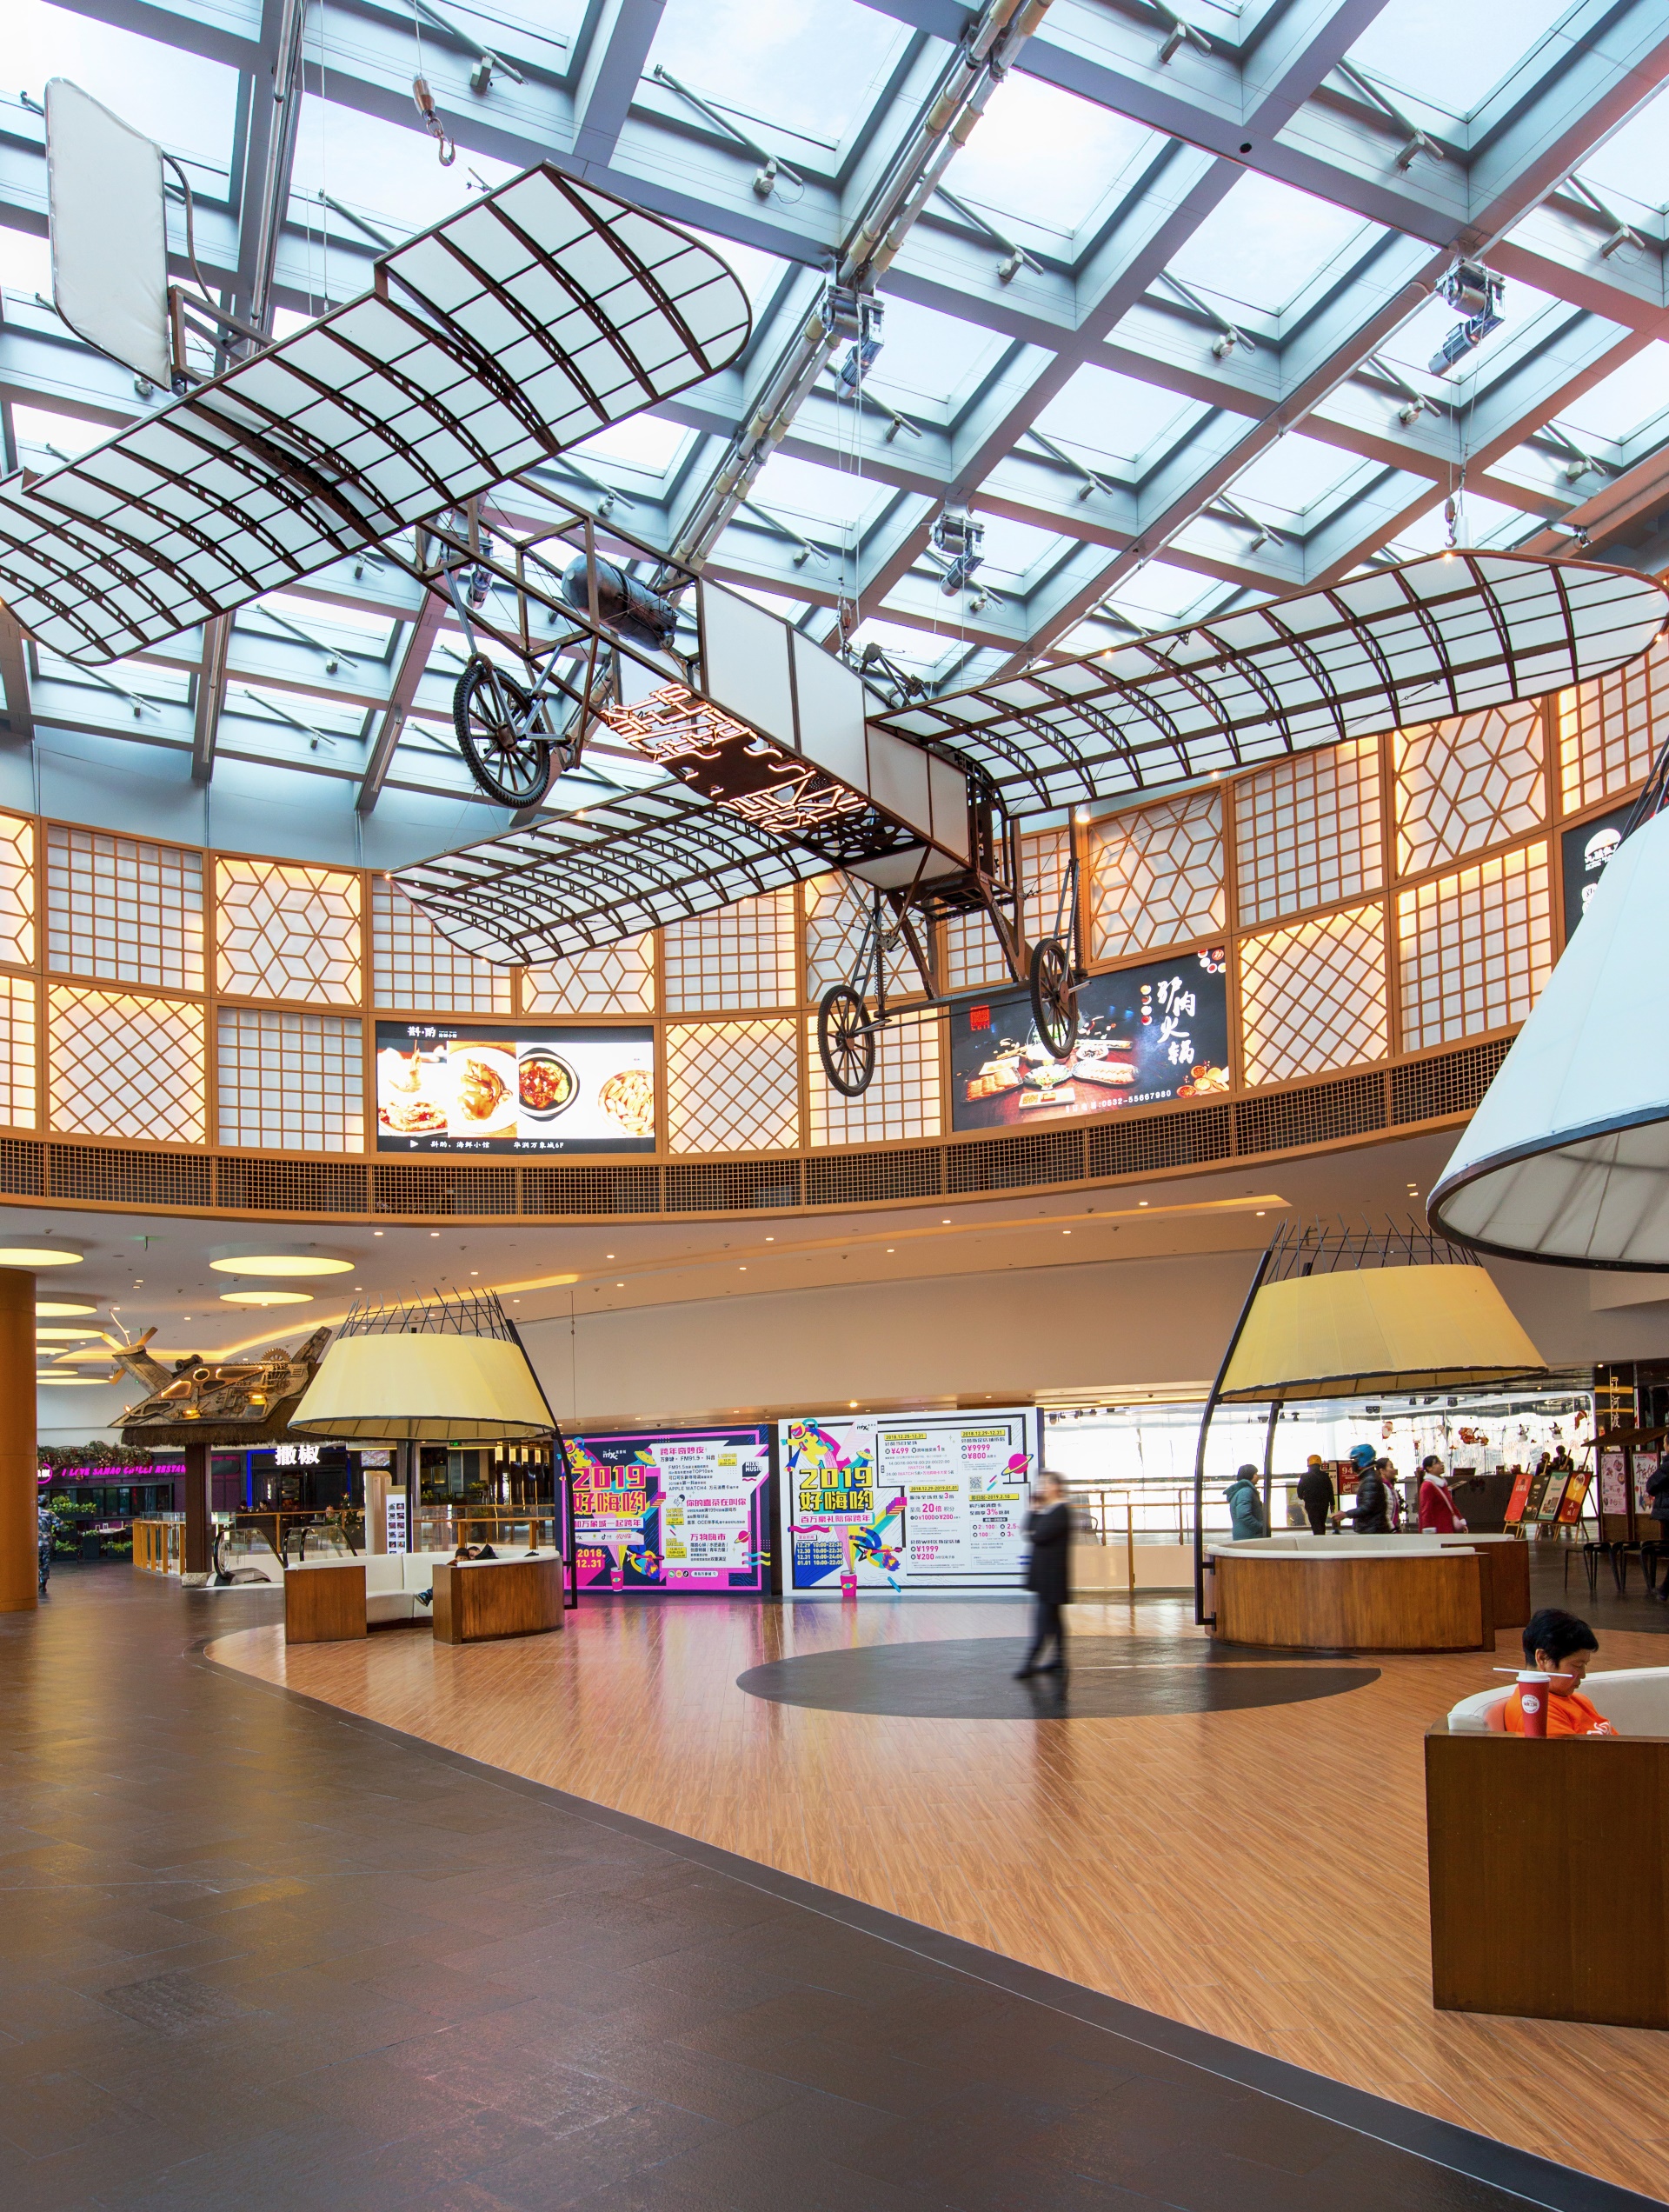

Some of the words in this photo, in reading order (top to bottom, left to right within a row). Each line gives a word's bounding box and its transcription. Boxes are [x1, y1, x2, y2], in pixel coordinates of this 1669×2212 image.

[275, 1445, 320, 1465] 撒椒
[571, 1464, 646, 1490] 2019
[799, 1467, 873, 1489] 2019
[572, 1491, 646, 1515] 好嗨哟
[799, 1490, 874, 1512] 好嗨哟
[575, 1559, 602, 1568] 12.31
